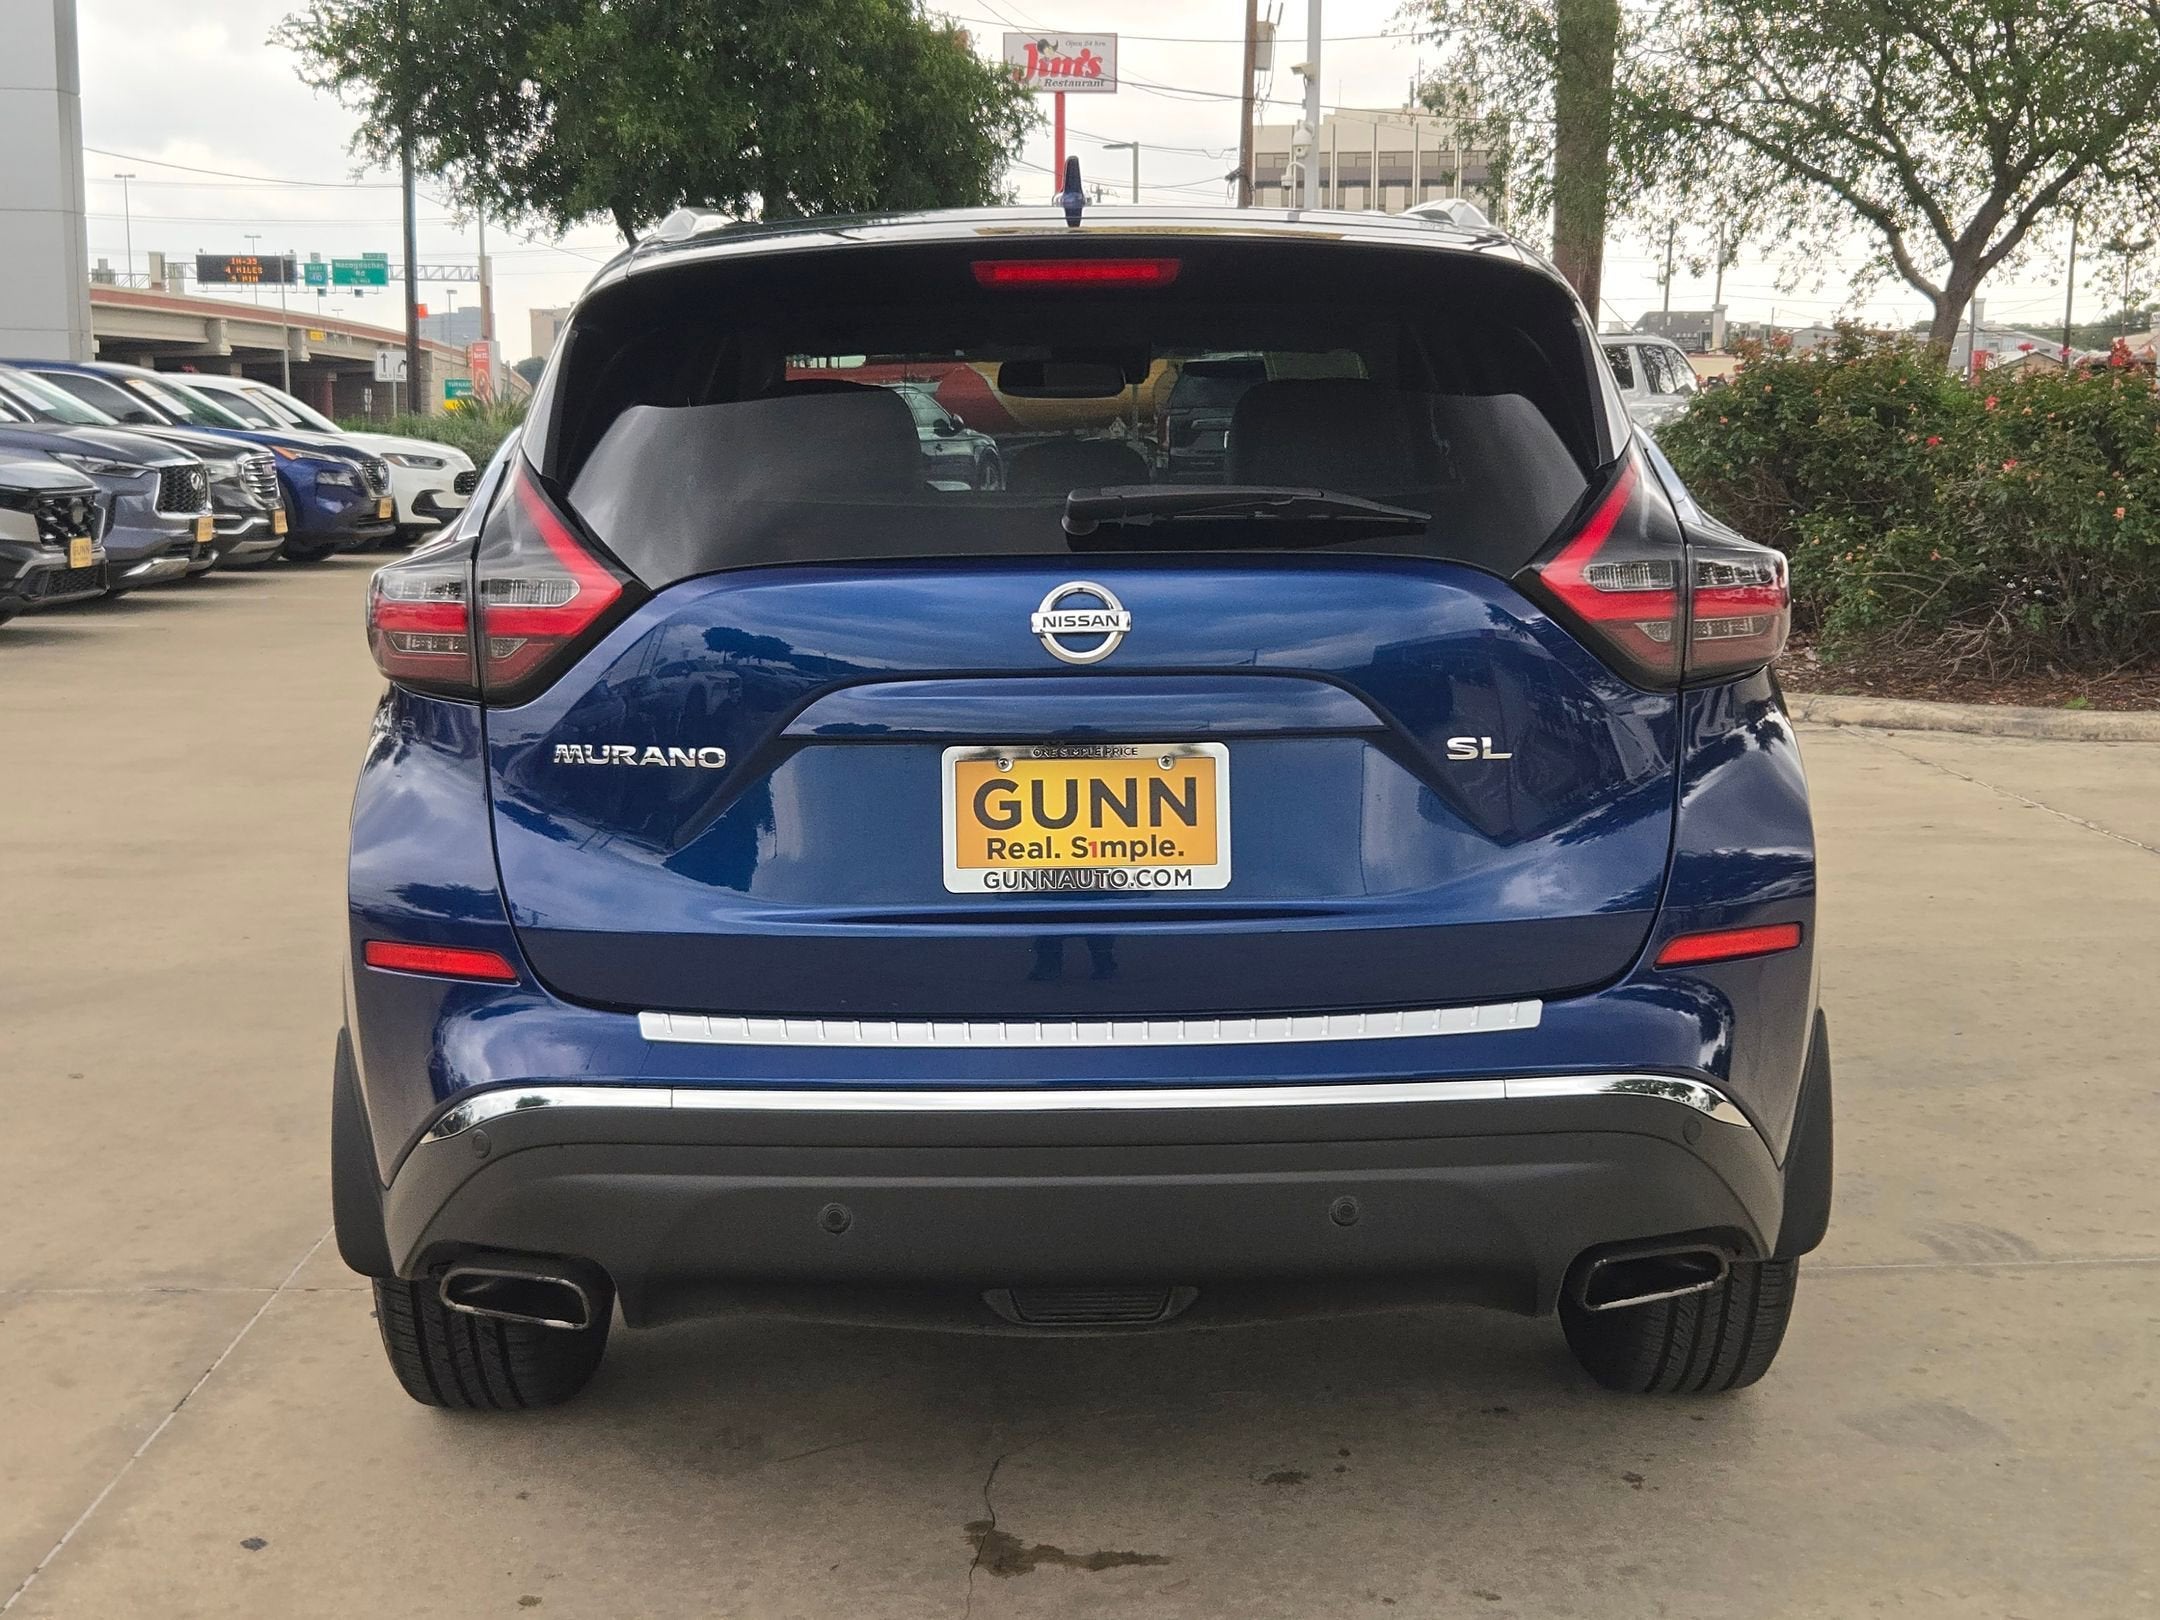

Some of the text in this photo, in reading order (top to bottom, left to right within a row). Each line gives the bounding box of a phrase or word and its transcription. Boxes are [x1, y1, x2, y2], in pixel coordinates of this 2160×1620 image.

[1012, 42, 1104, 84] Jim's
[1044, 78, 1105, 87] Restaurant
[236, 266, 263, 274] MILES
[1042, 615, 1120, 628] NISSAN
[553, 744, 727, 769] MURANO
[1032, 746, 1139, 758] ONE SIMPLE PRICE
[1446, 736, 1513, 760] SL
[972, 777, 1198, 831] GUNN
[986, 836, 1062, 860] Real.
[983, 868, 1193, 890] GUNNAUTO.COM
